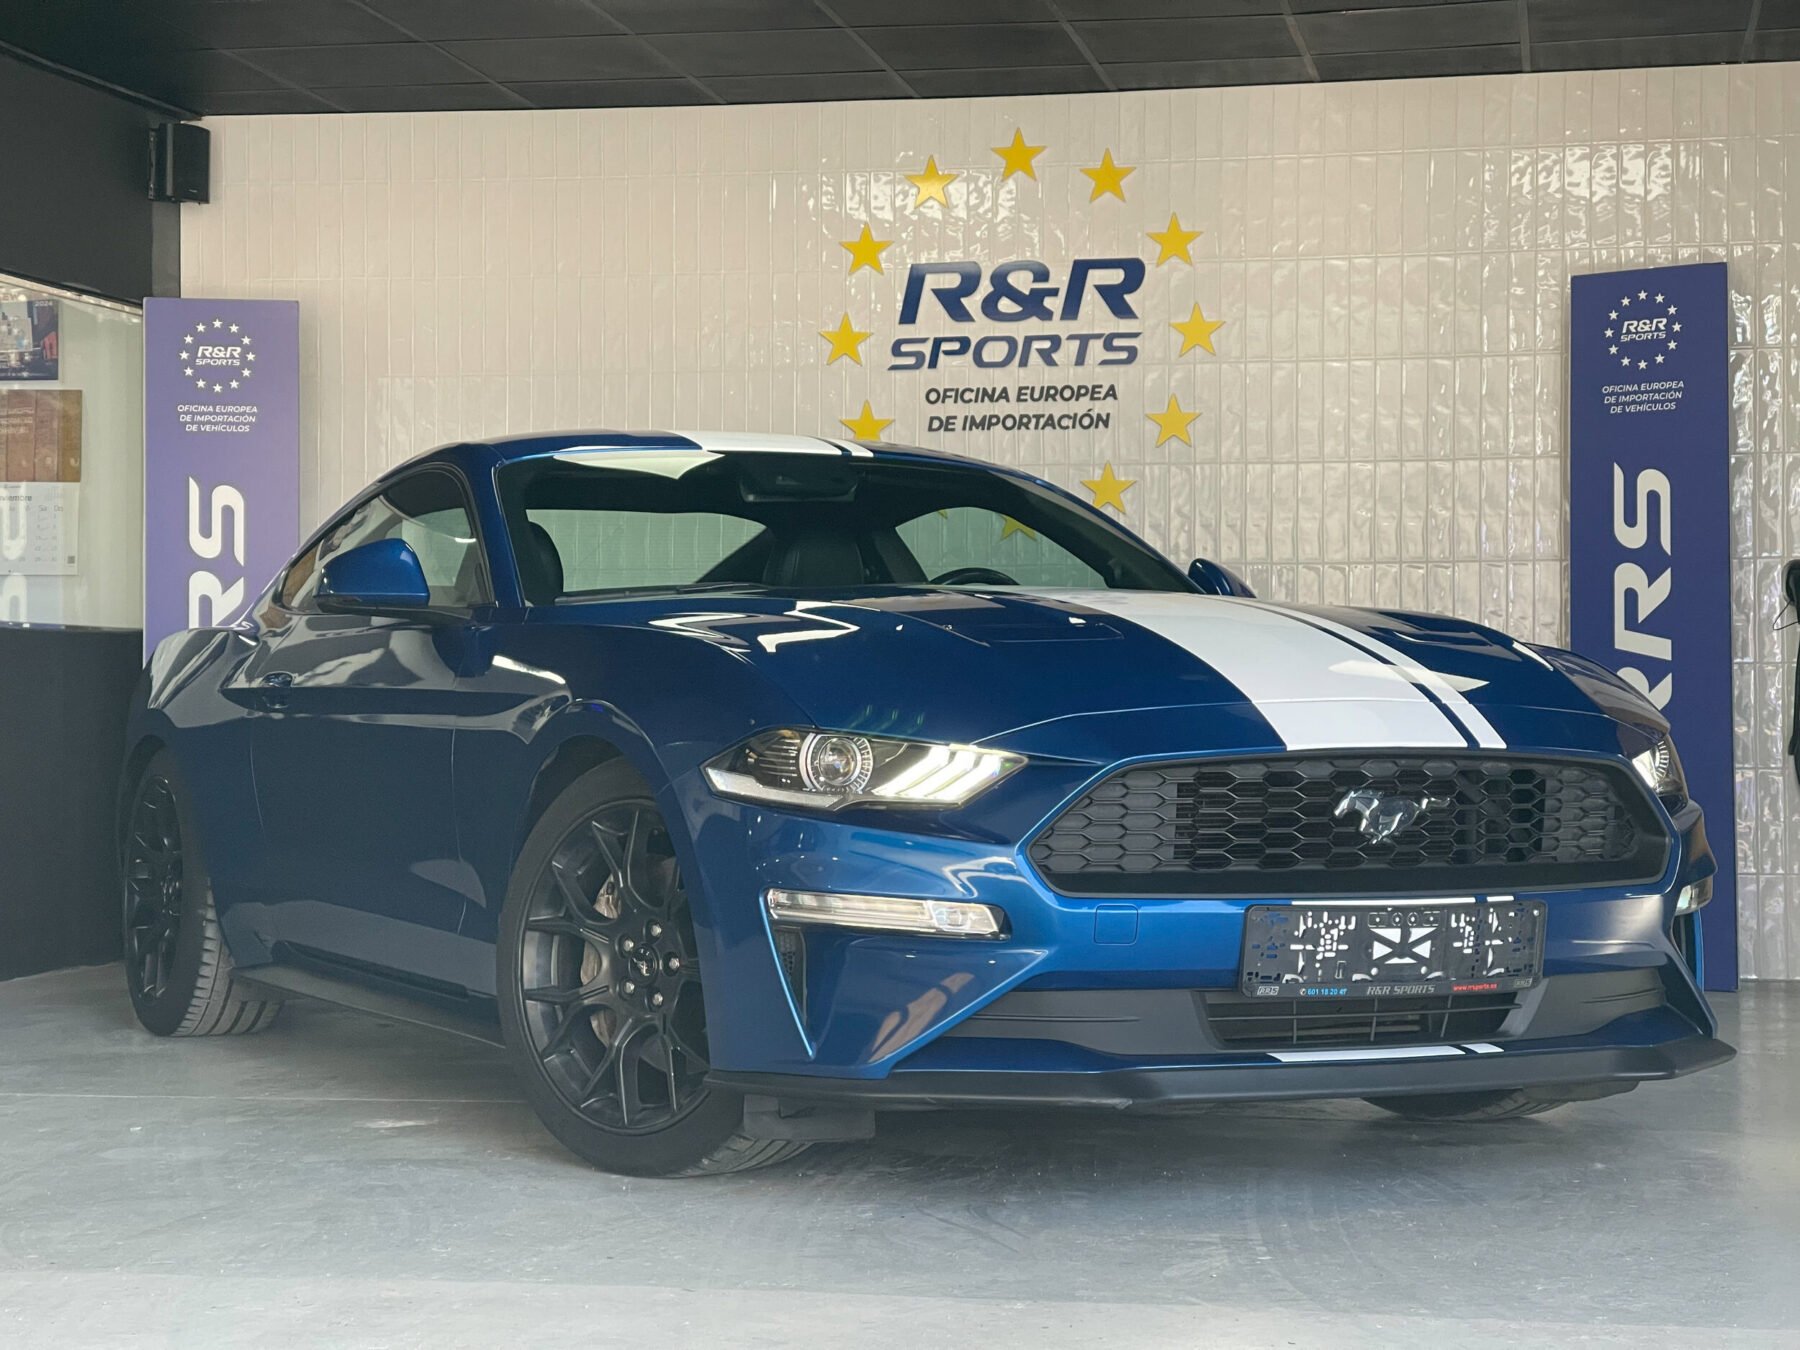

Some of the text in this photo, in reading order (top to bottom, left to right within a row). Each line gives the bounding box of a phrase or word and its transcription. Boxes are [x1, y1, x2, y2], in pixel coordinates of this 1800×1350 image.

[898, 257, 1146, 325] R&R
[1622, 318, 1667, 333] R&R
[1620, 331, 1666, 342] SPORTS
[197, 346, 241, 358] R&R
[887, 331, 1143, 371] SPORTS
[195, 358, 240, 366] SPORTS
[1602, 381, 1684, 393] OFICINA EUROPEA
[925, 384, 1118, 404] OFICINA EUROPEA
[1604, 390, 1682, 404] DE IMPORTACIÓN
[215, 405, 257, 413] EUROPEA
[1610, 402, 1676, 414] DE VEHÍCULOS
[180, 414, 255, 423] DE IMPORTACIÓN
[928, 409, 1110, 432] DE IMPORTACIÓN
[185, 423, 250, 432] DE VEHÍCULOS
[1366, 984, 1435, 995] R&R SPORTS
